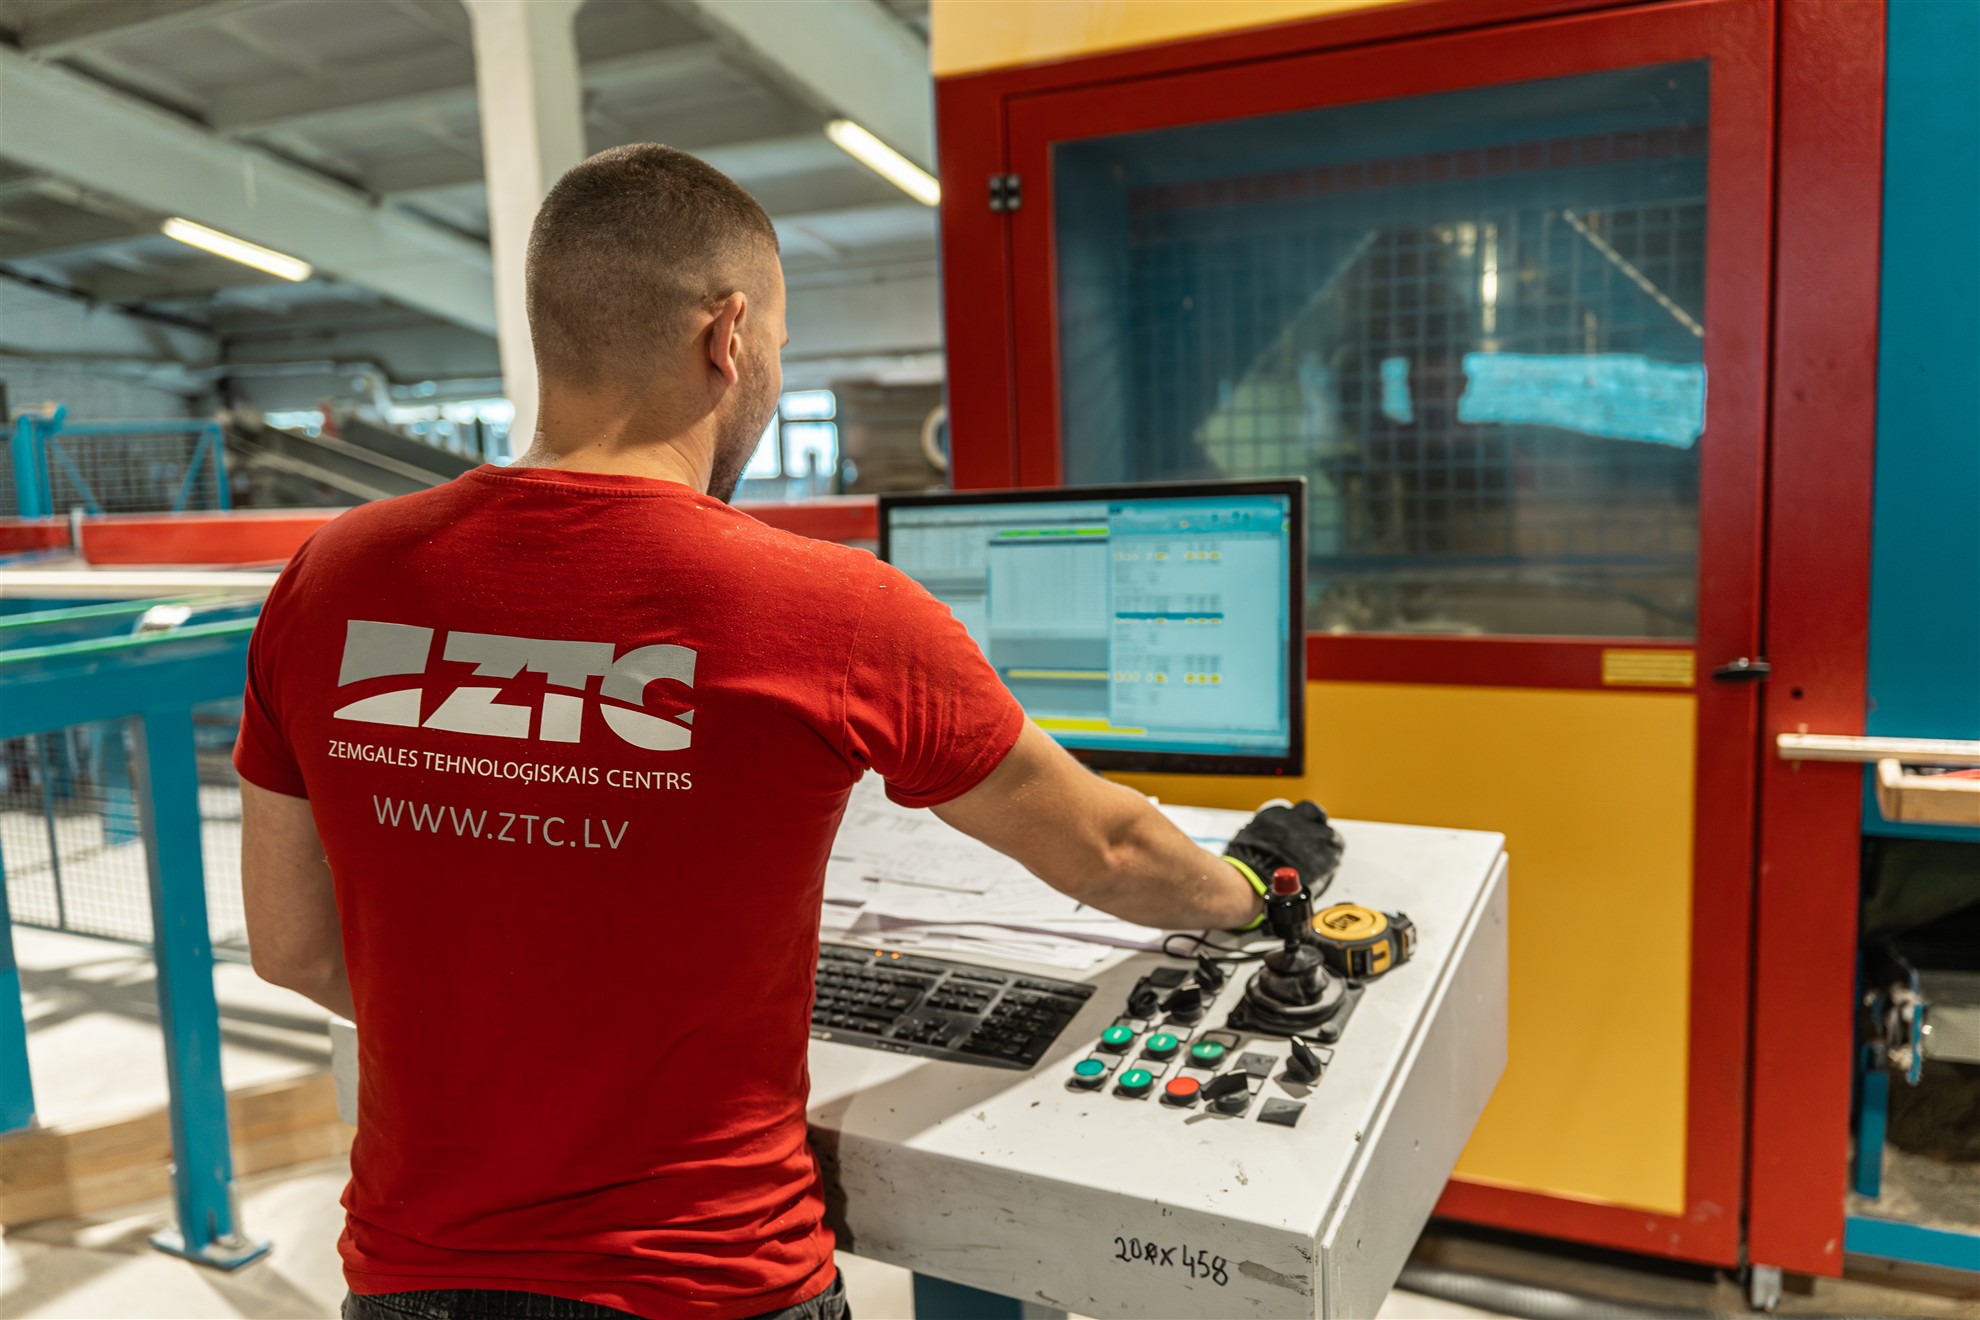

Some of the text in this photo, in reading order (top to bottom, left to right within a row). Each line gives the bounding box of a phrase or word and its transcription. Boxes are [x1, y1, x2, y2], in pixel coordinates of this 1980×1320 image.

[421, 630, 698, 752] ZTC
[328, 739, 693, 791] ZEMGALES TEHNOLOĢISKAIS CENTRS
[373, 794, 630, 849] WWW.ZTC.LV
